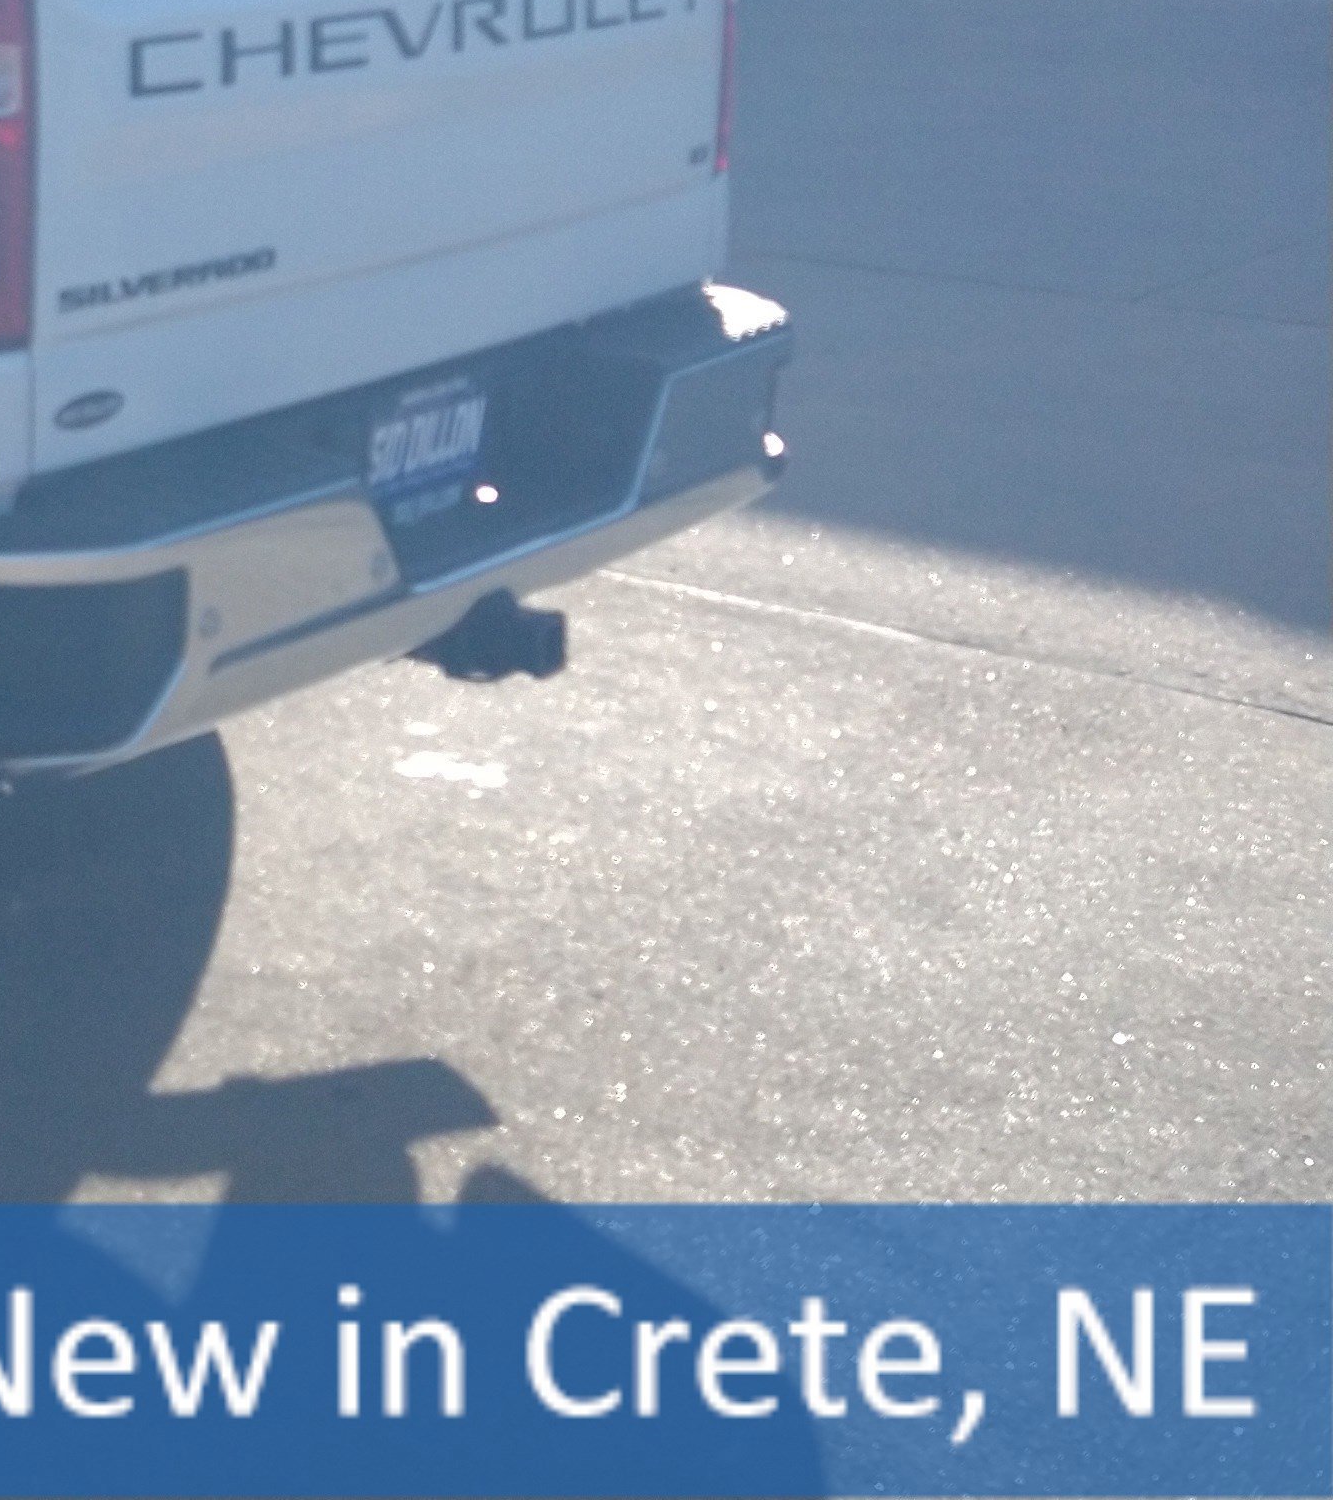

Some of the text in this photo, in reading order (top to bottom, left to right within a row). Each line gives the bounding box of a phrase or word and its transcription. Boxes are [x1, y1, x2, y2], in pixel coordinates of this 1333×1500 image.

[58, 247, 277, 314] SILVERADO
[369, 395, 487, 483] SID DILLON
